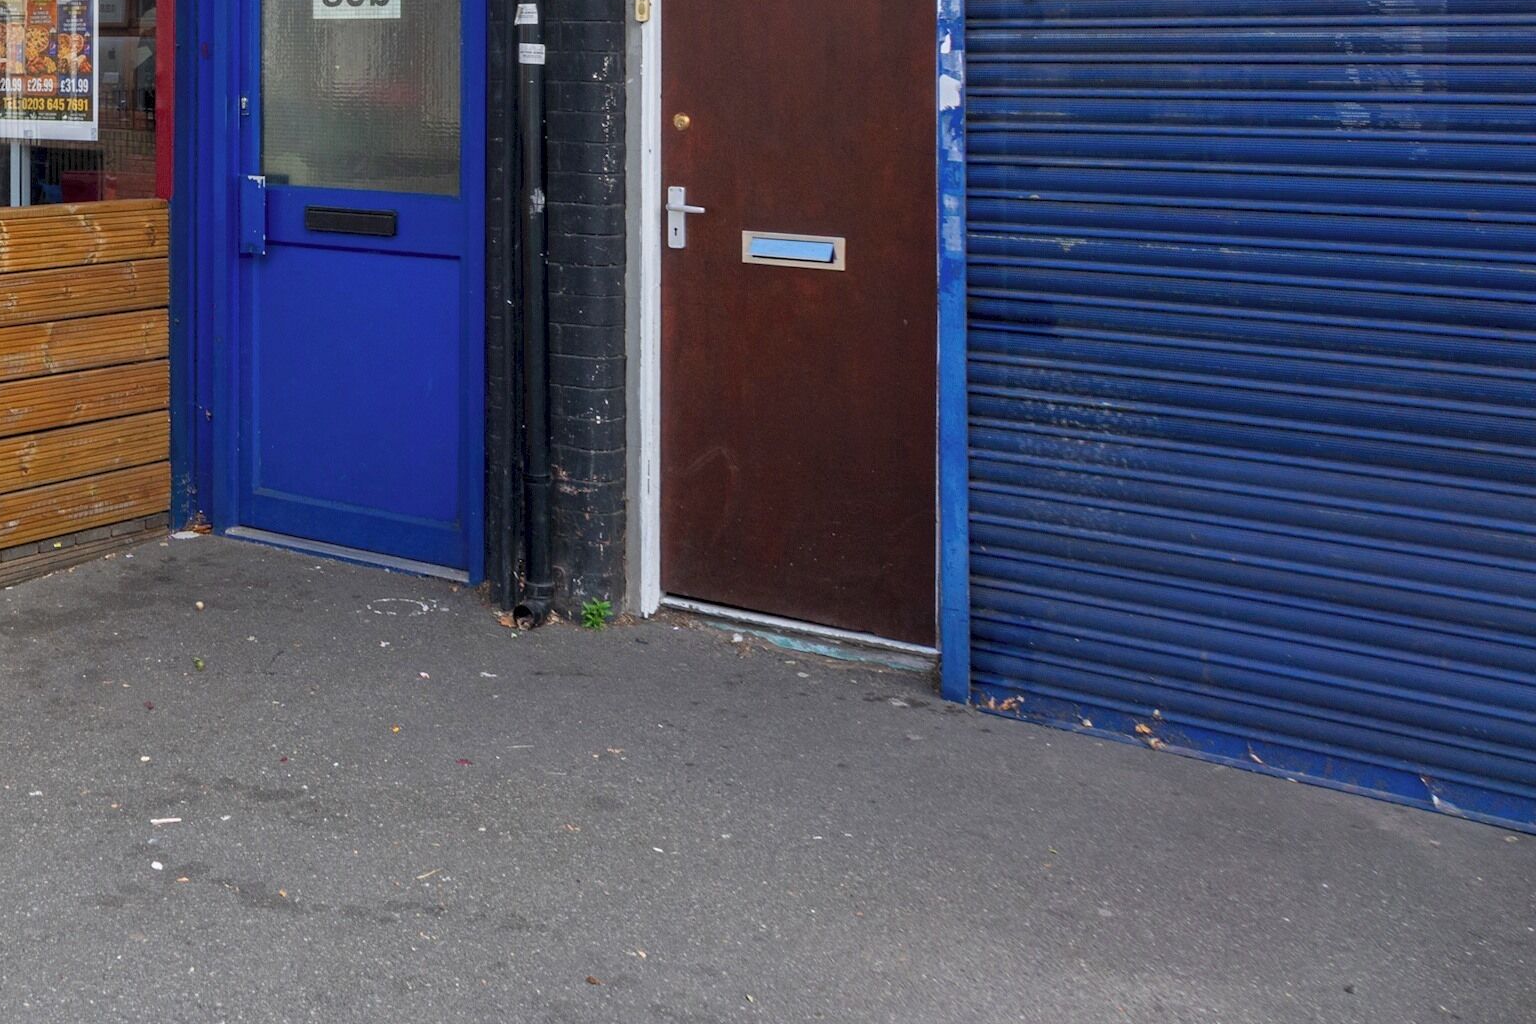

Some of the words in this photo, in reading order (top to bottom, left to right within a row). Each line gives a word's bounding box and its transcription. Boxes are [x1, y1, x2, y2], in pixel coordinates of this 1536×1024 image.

[27, 77, 54, 93] £26.99
[60, 77, 89, 93] £31.99
[22, 97, 45, 111] 0203
[47, 97, 65, 111] 645
[67, 97, 89, 112] 7691
